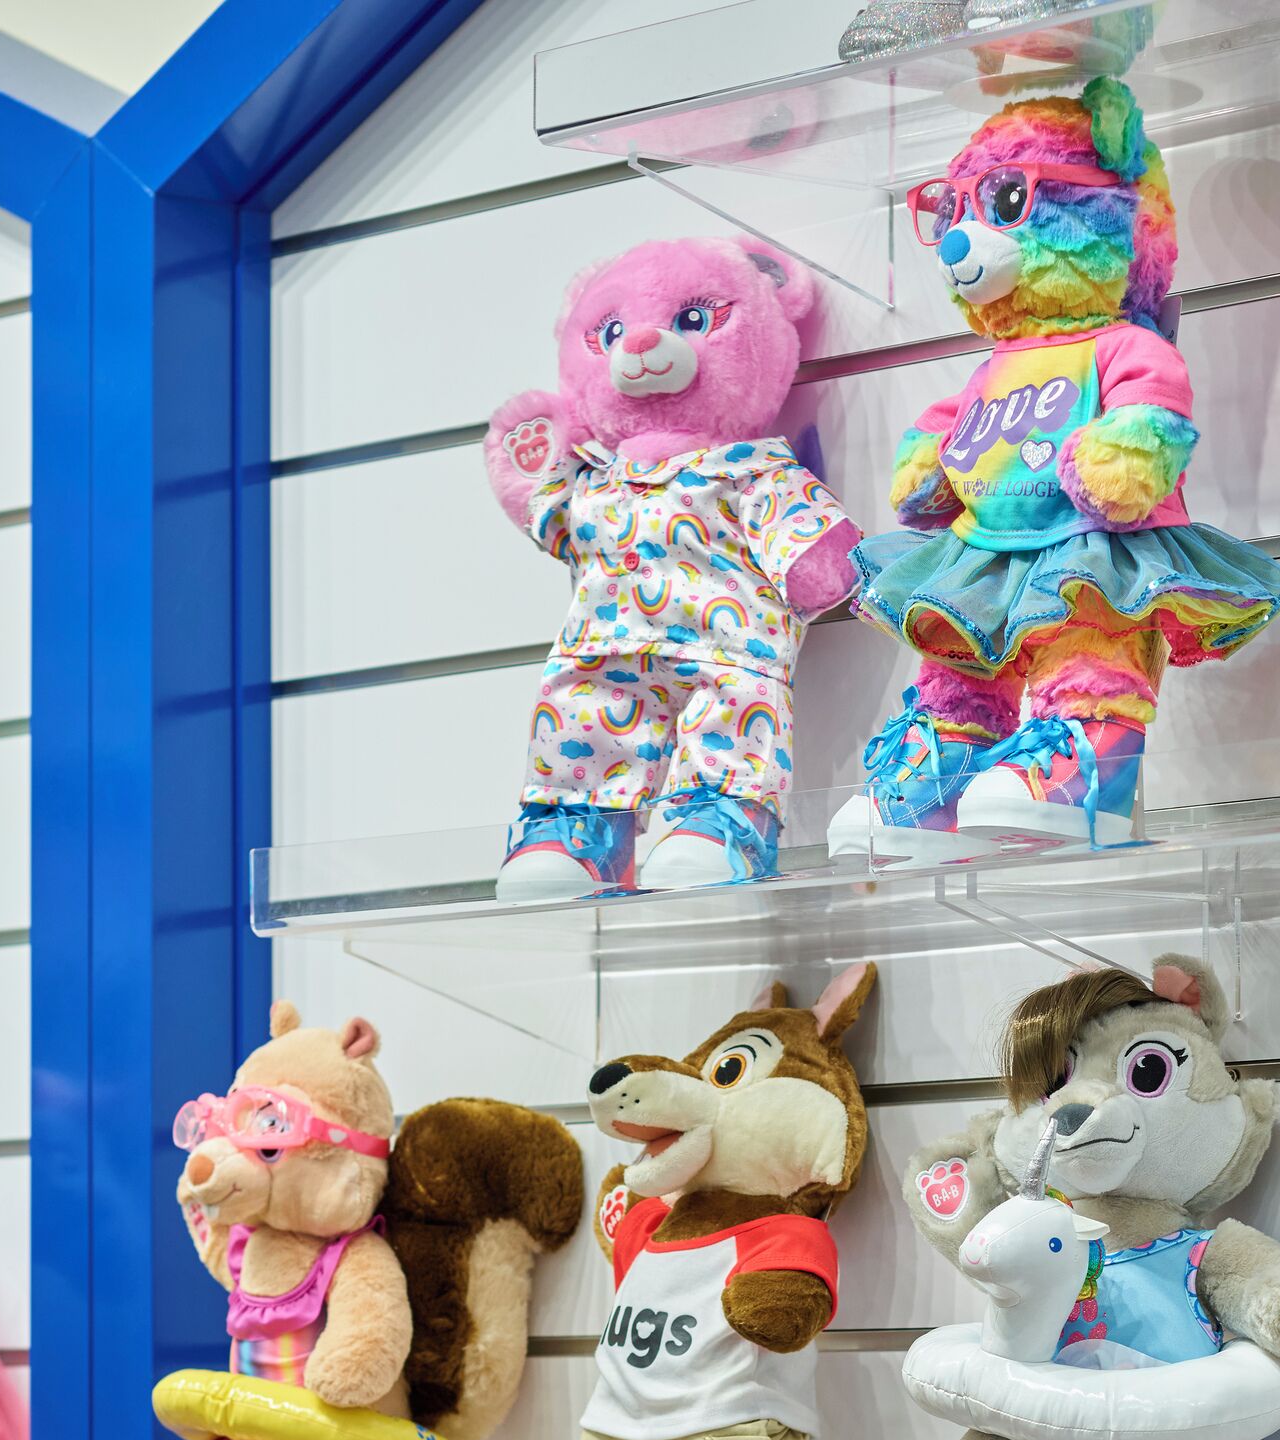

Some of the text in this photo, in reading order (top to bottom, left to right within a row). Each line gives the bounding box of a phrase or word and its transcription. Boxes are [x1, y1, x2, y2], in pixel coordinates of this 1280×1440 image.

[944, 379, 1068, 461] Love
[1004, 480, 1058, 498] LODGE
[600, 1305, 698, 1369] ugs
